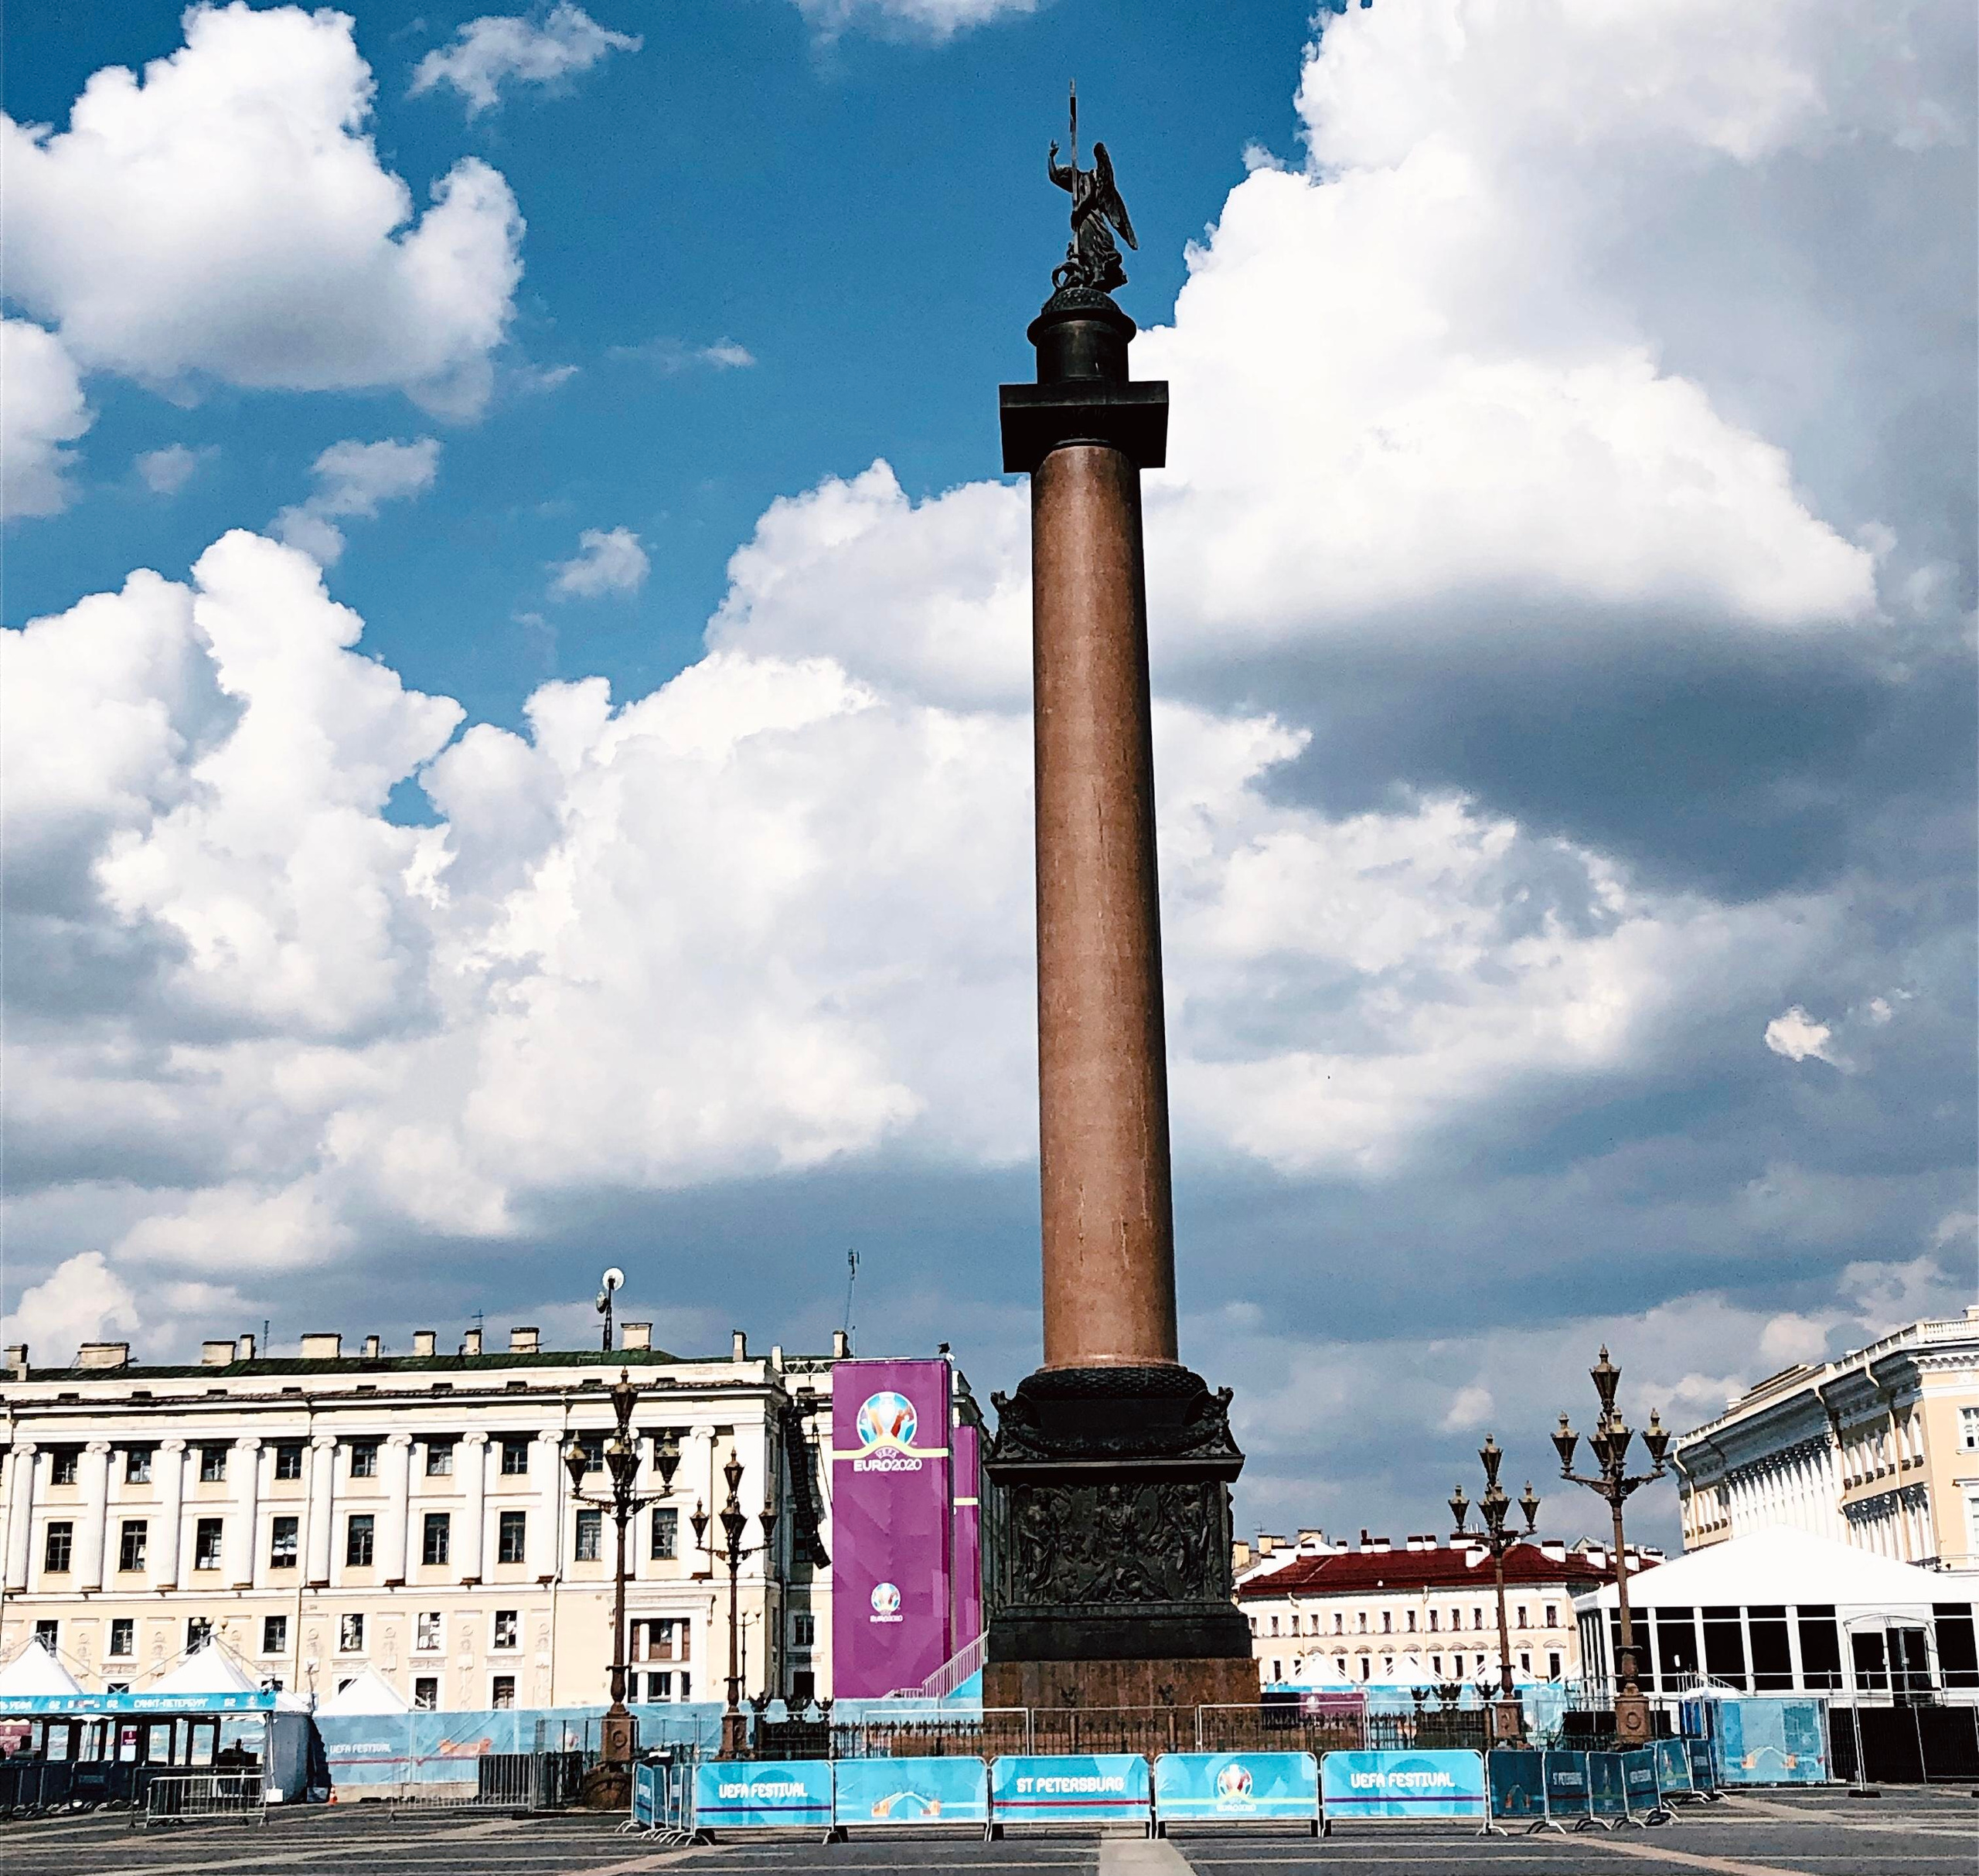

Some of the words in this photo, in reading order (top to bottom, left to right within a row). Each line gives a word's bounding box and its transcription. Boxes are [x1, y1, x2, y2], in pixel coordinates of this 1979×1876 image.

[874, 1446, 900, 1459] UEFA
[853, 1458, 923, 1473] EURO2020
[329, 1744, 351, 1754] UEFA
[352, 1743, 392, 1753] FESTIVAL
[1016, 1777, 1034, 1793] ST
[1036, 1776, 1126, 1793] PETERSBURG
[1350, 1772, 1386, 1789] UEFA
[1388, 1772, 1456, 1788] FESTIVAL
[719, 1783, 749, 1799] UEFA
[751, 1782, 809, 1798] FESTIVAL
